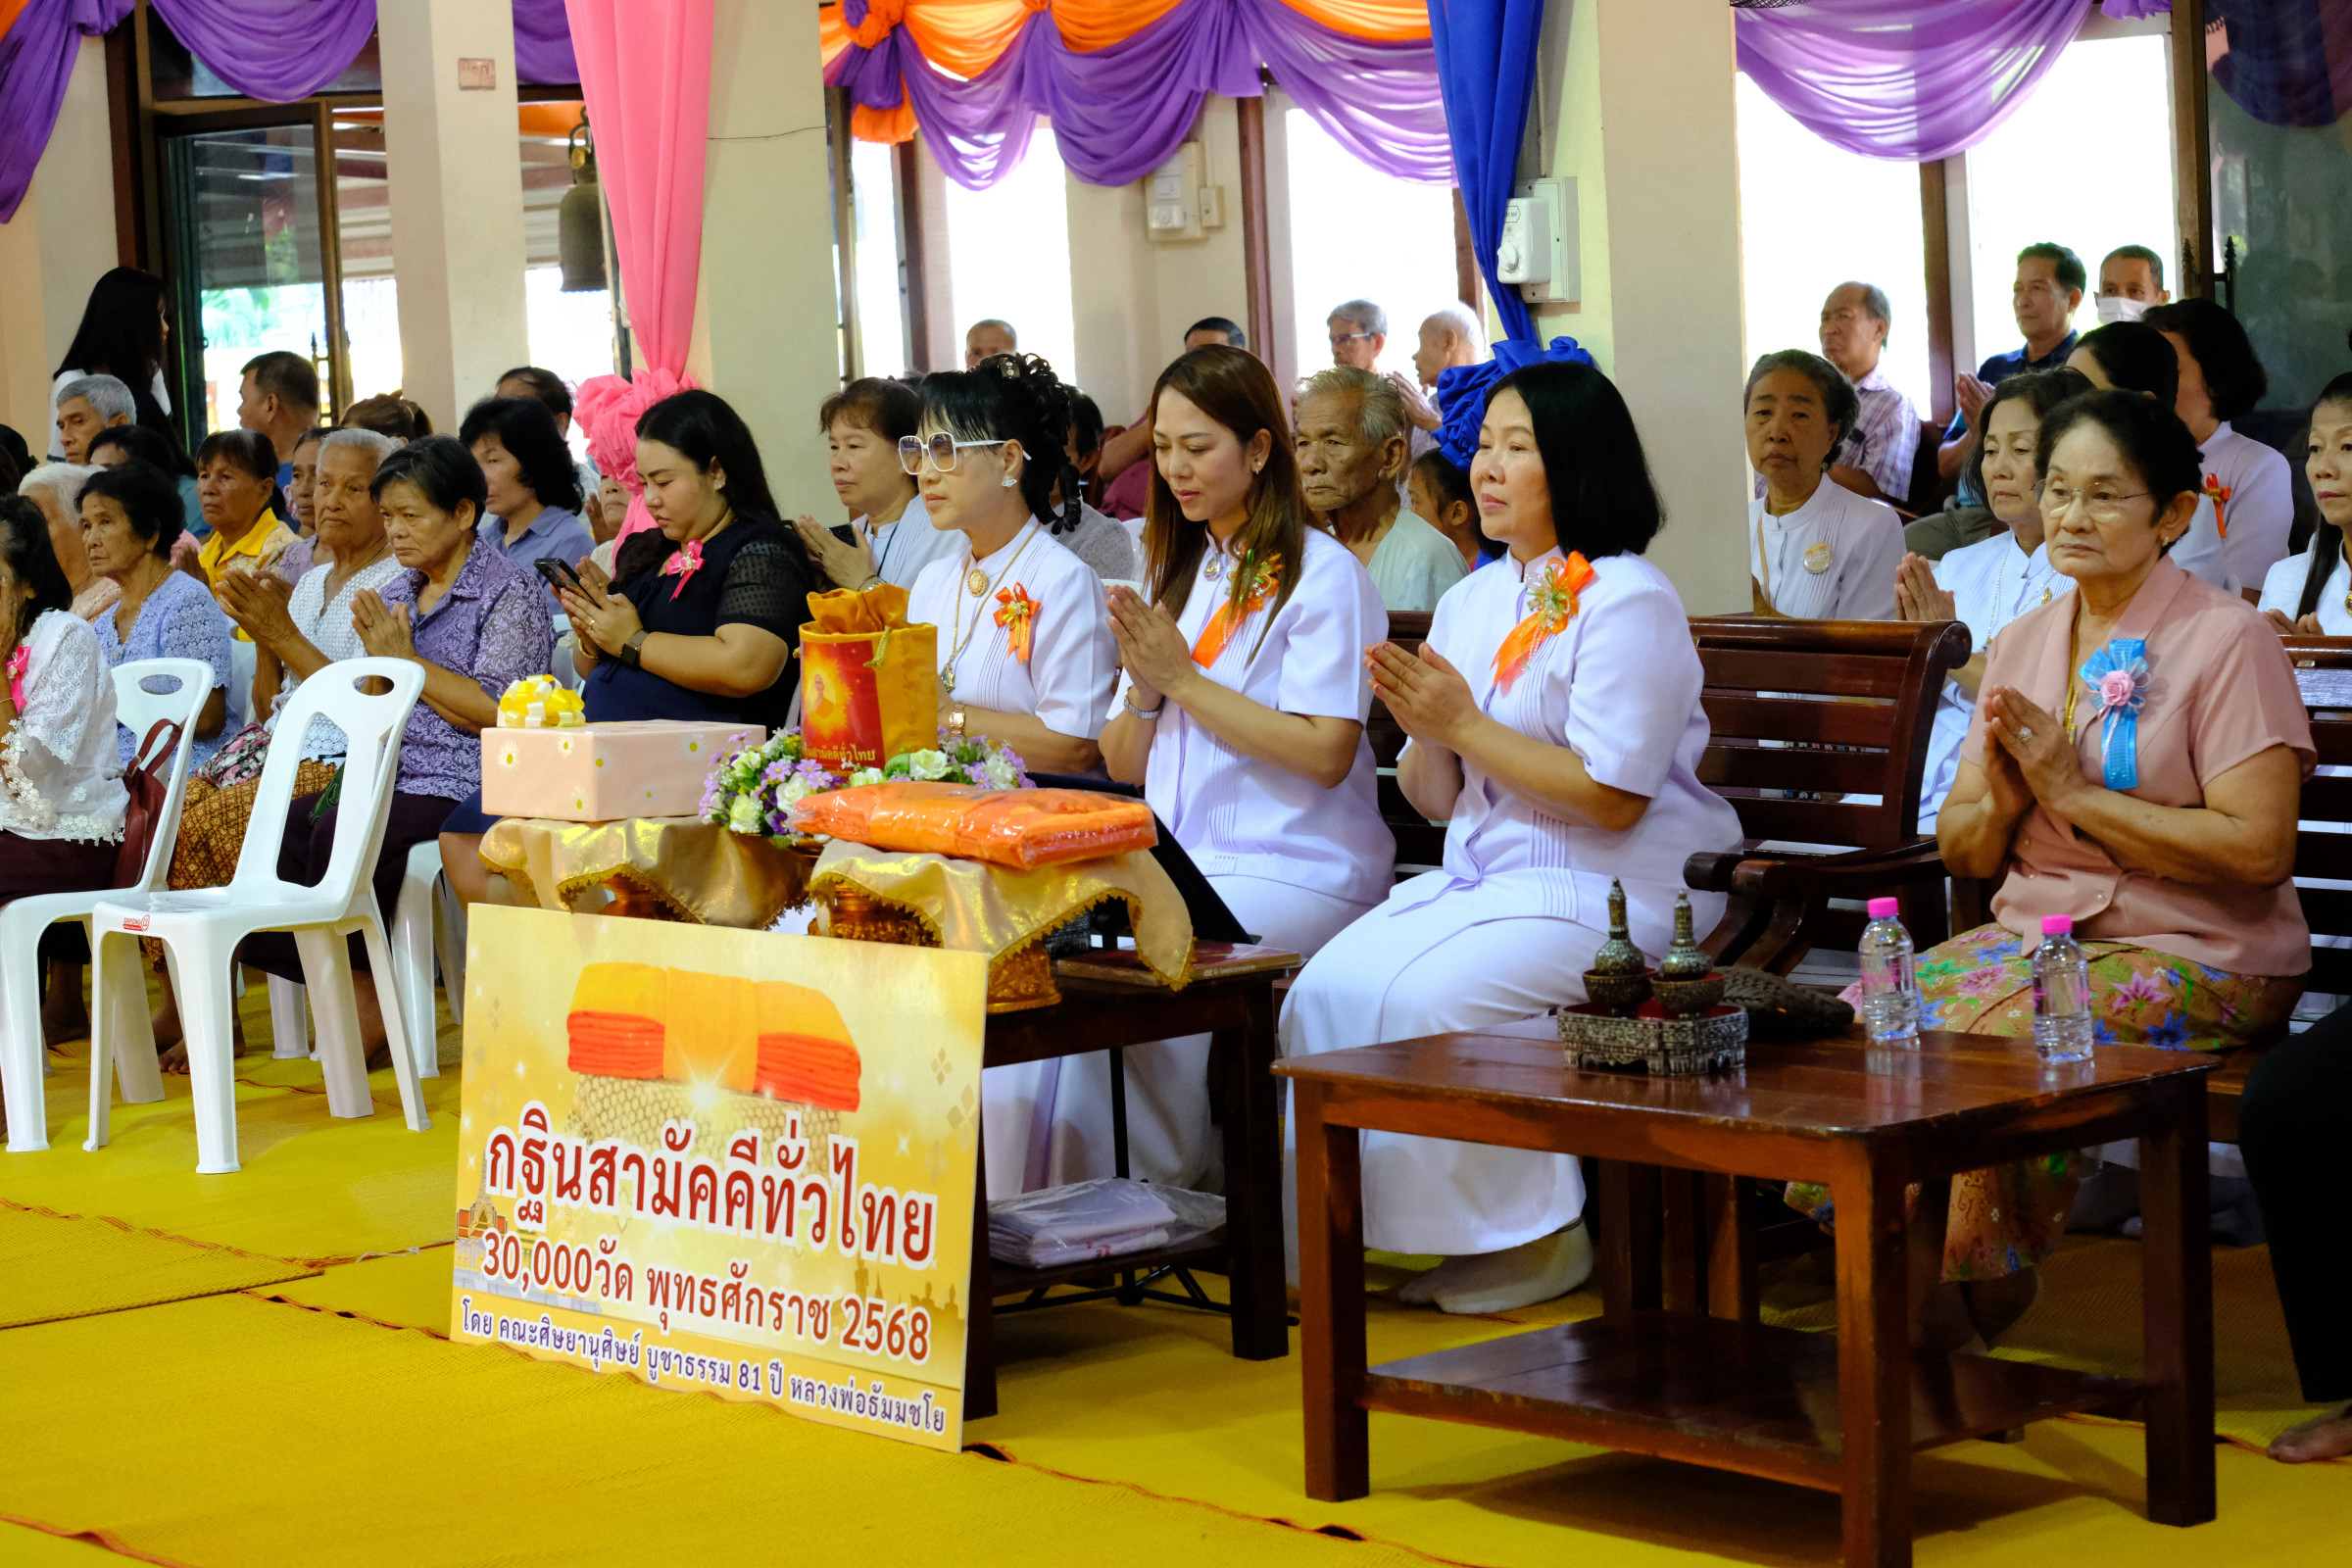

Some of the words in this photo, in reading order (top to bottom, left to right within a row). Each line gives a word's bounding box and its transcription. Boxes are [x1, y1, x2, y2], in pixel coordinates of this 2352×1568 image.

[488, 1107, 932, 1262] กฐินสามัคคีทั่วไทย
[483, 1231, 633, 1301] 30,000วัด
[647, 1261, 830, 1340] พุทธศักราช
[842, 1298, 930, 1360] 2568
[462, 1298, 492, 1334] โดย
[499, 1316, 642, 1369] คณะศิษยานุศิษย์
[647, 1347, 730, 1384] บูชาธรรม
[738, 1363, 761, 1391] 81
[769, 1361, 783, 1396] ปี
[790, 1377, 945, 1432] หลวงพ่อธัมมชโย
